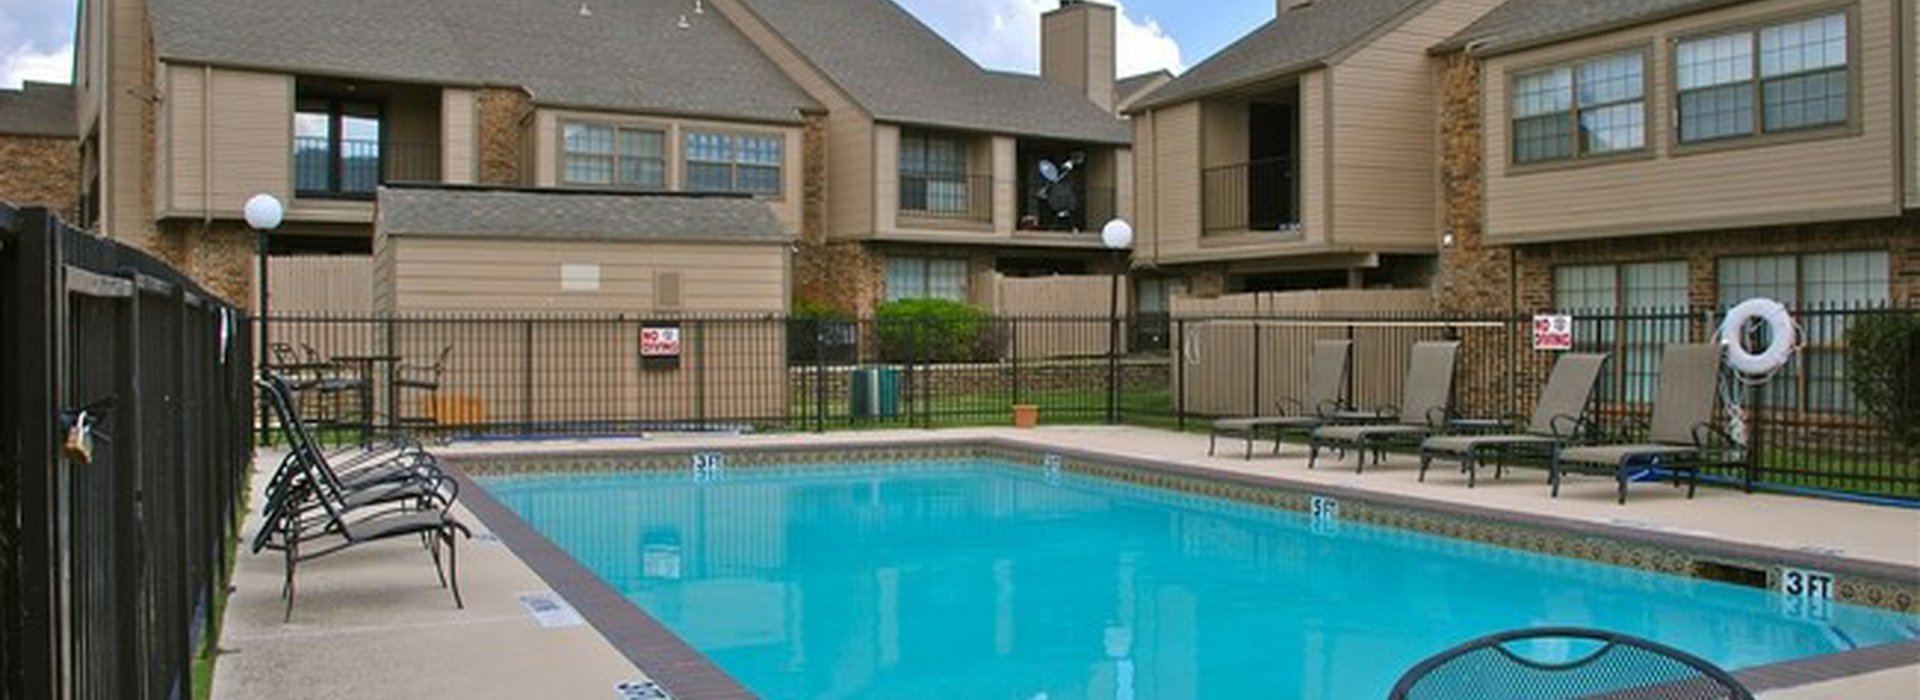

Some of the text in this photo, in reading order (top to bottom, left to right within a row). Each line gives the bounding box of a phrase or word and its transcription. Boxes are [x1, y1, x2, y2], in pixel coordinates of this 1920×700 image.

[1535, 319, 1550, 331] NO
[643, 331, 658, 341] NO
[1535, 333, 1569, 346] DIVING
[643, 342, 678, 353] DIVING
[1786, 571, 1831, 599] 3 FT
